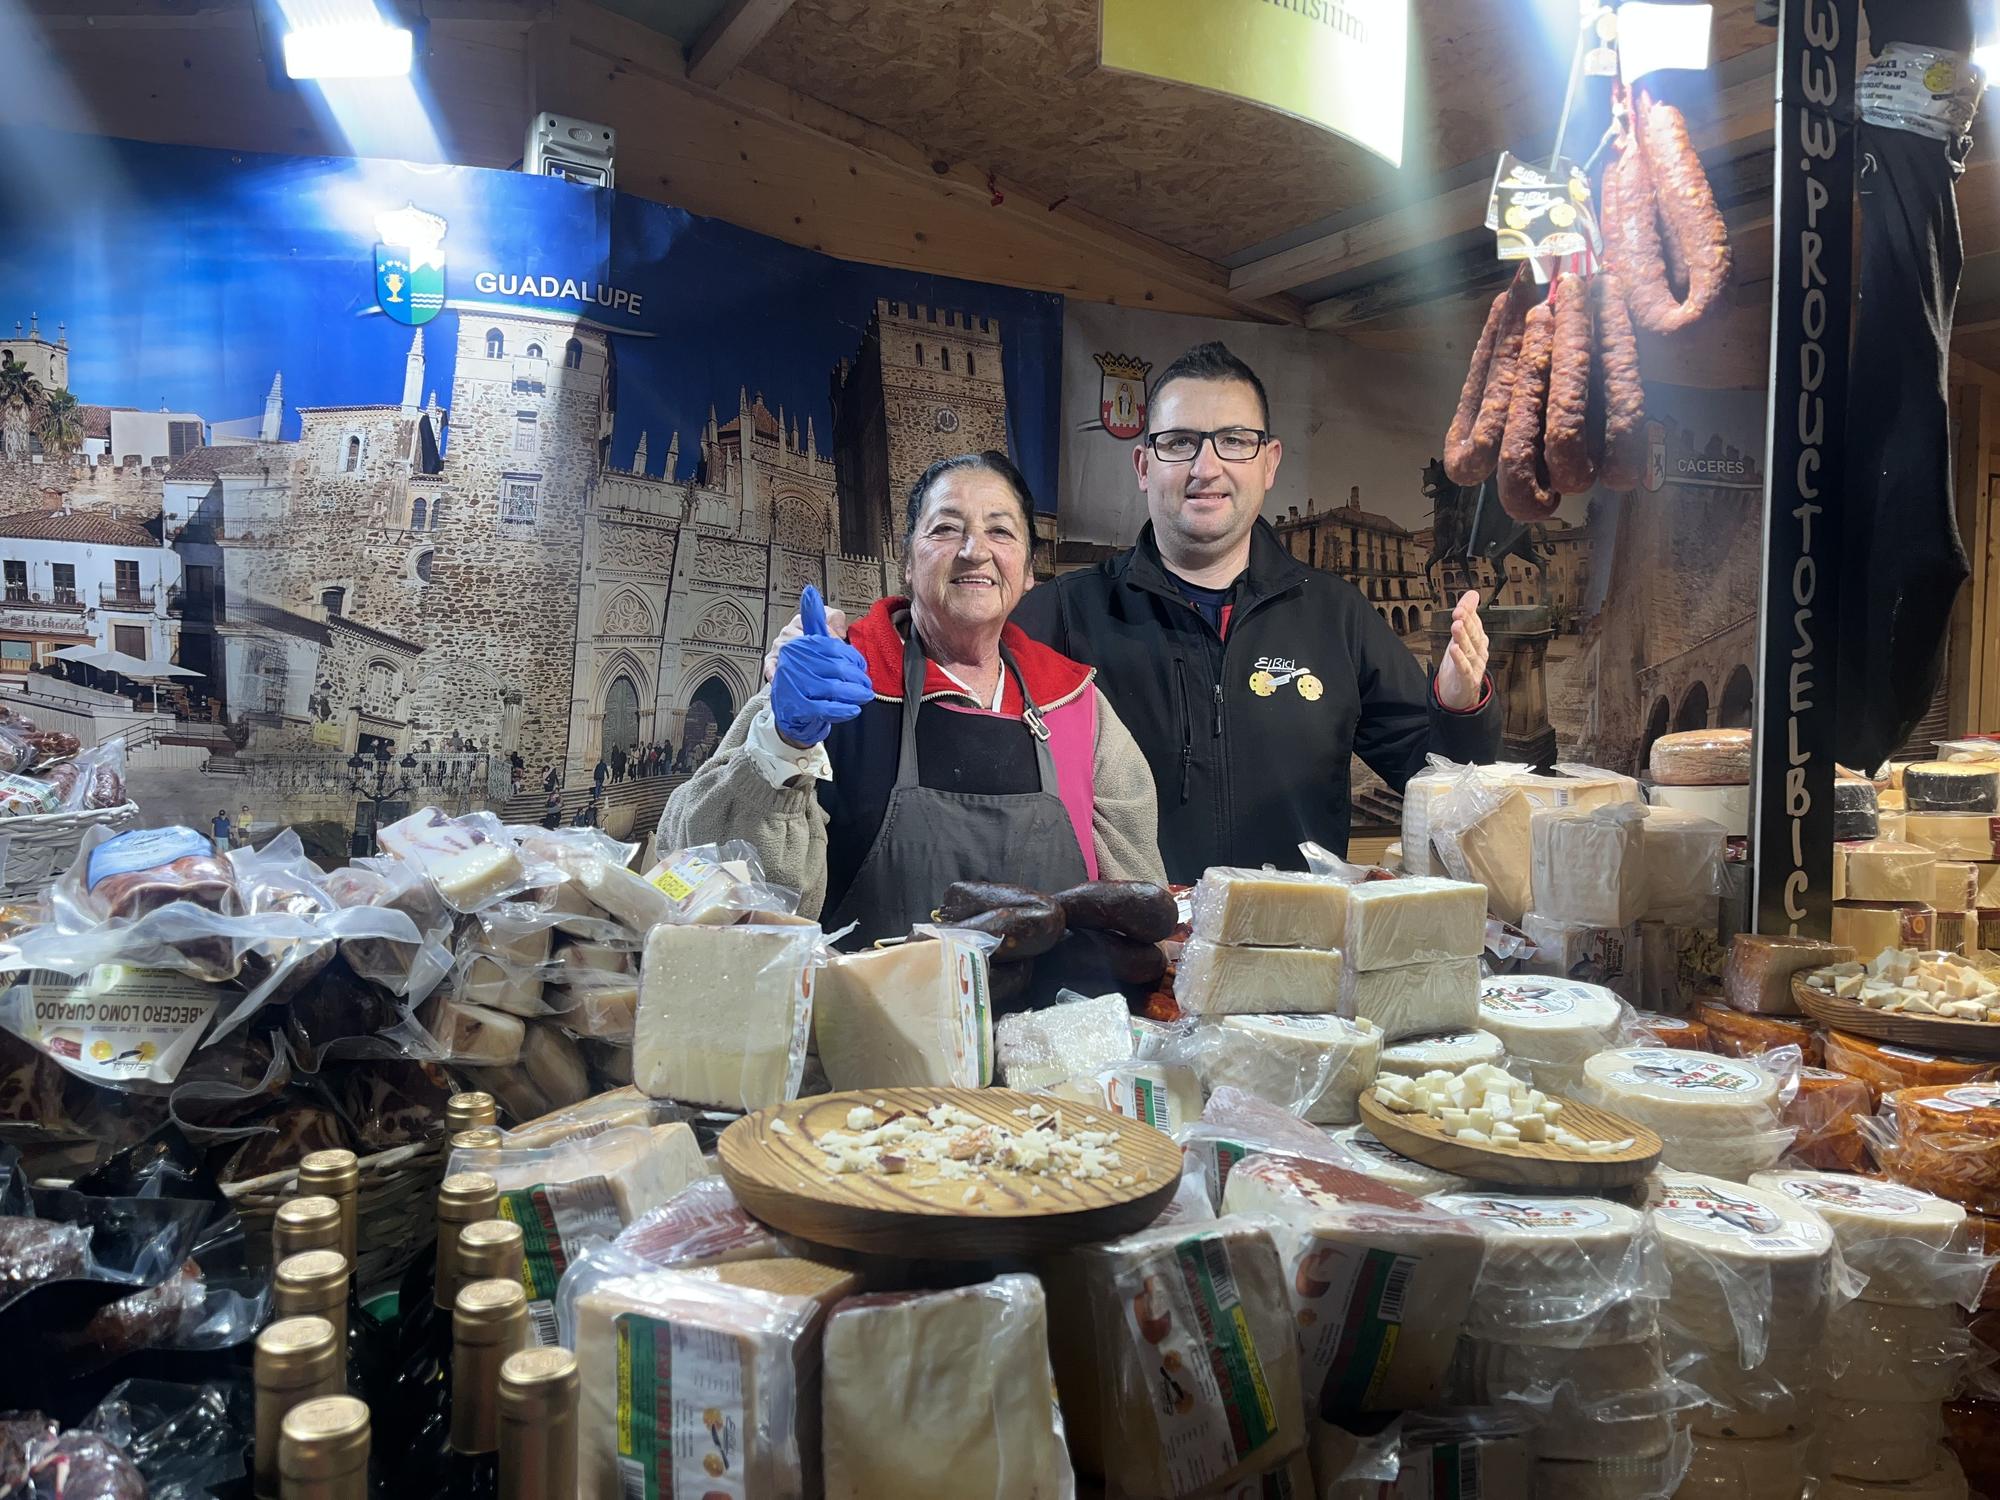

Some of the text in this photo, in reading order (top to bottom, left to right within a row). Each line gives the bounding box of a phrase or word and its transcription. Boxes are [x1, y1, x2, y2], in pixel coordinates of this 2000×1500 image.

[475, 272, 643, 315] GUADALUPE
[1678, 459, 1744, 474] CACERES
[1784, 0, 1840, 936] WWW.PRODUCTOSELBIC
[36, 1002, 95, 1020] CURADO
[100, 1004, 139, 1020] LOMO
